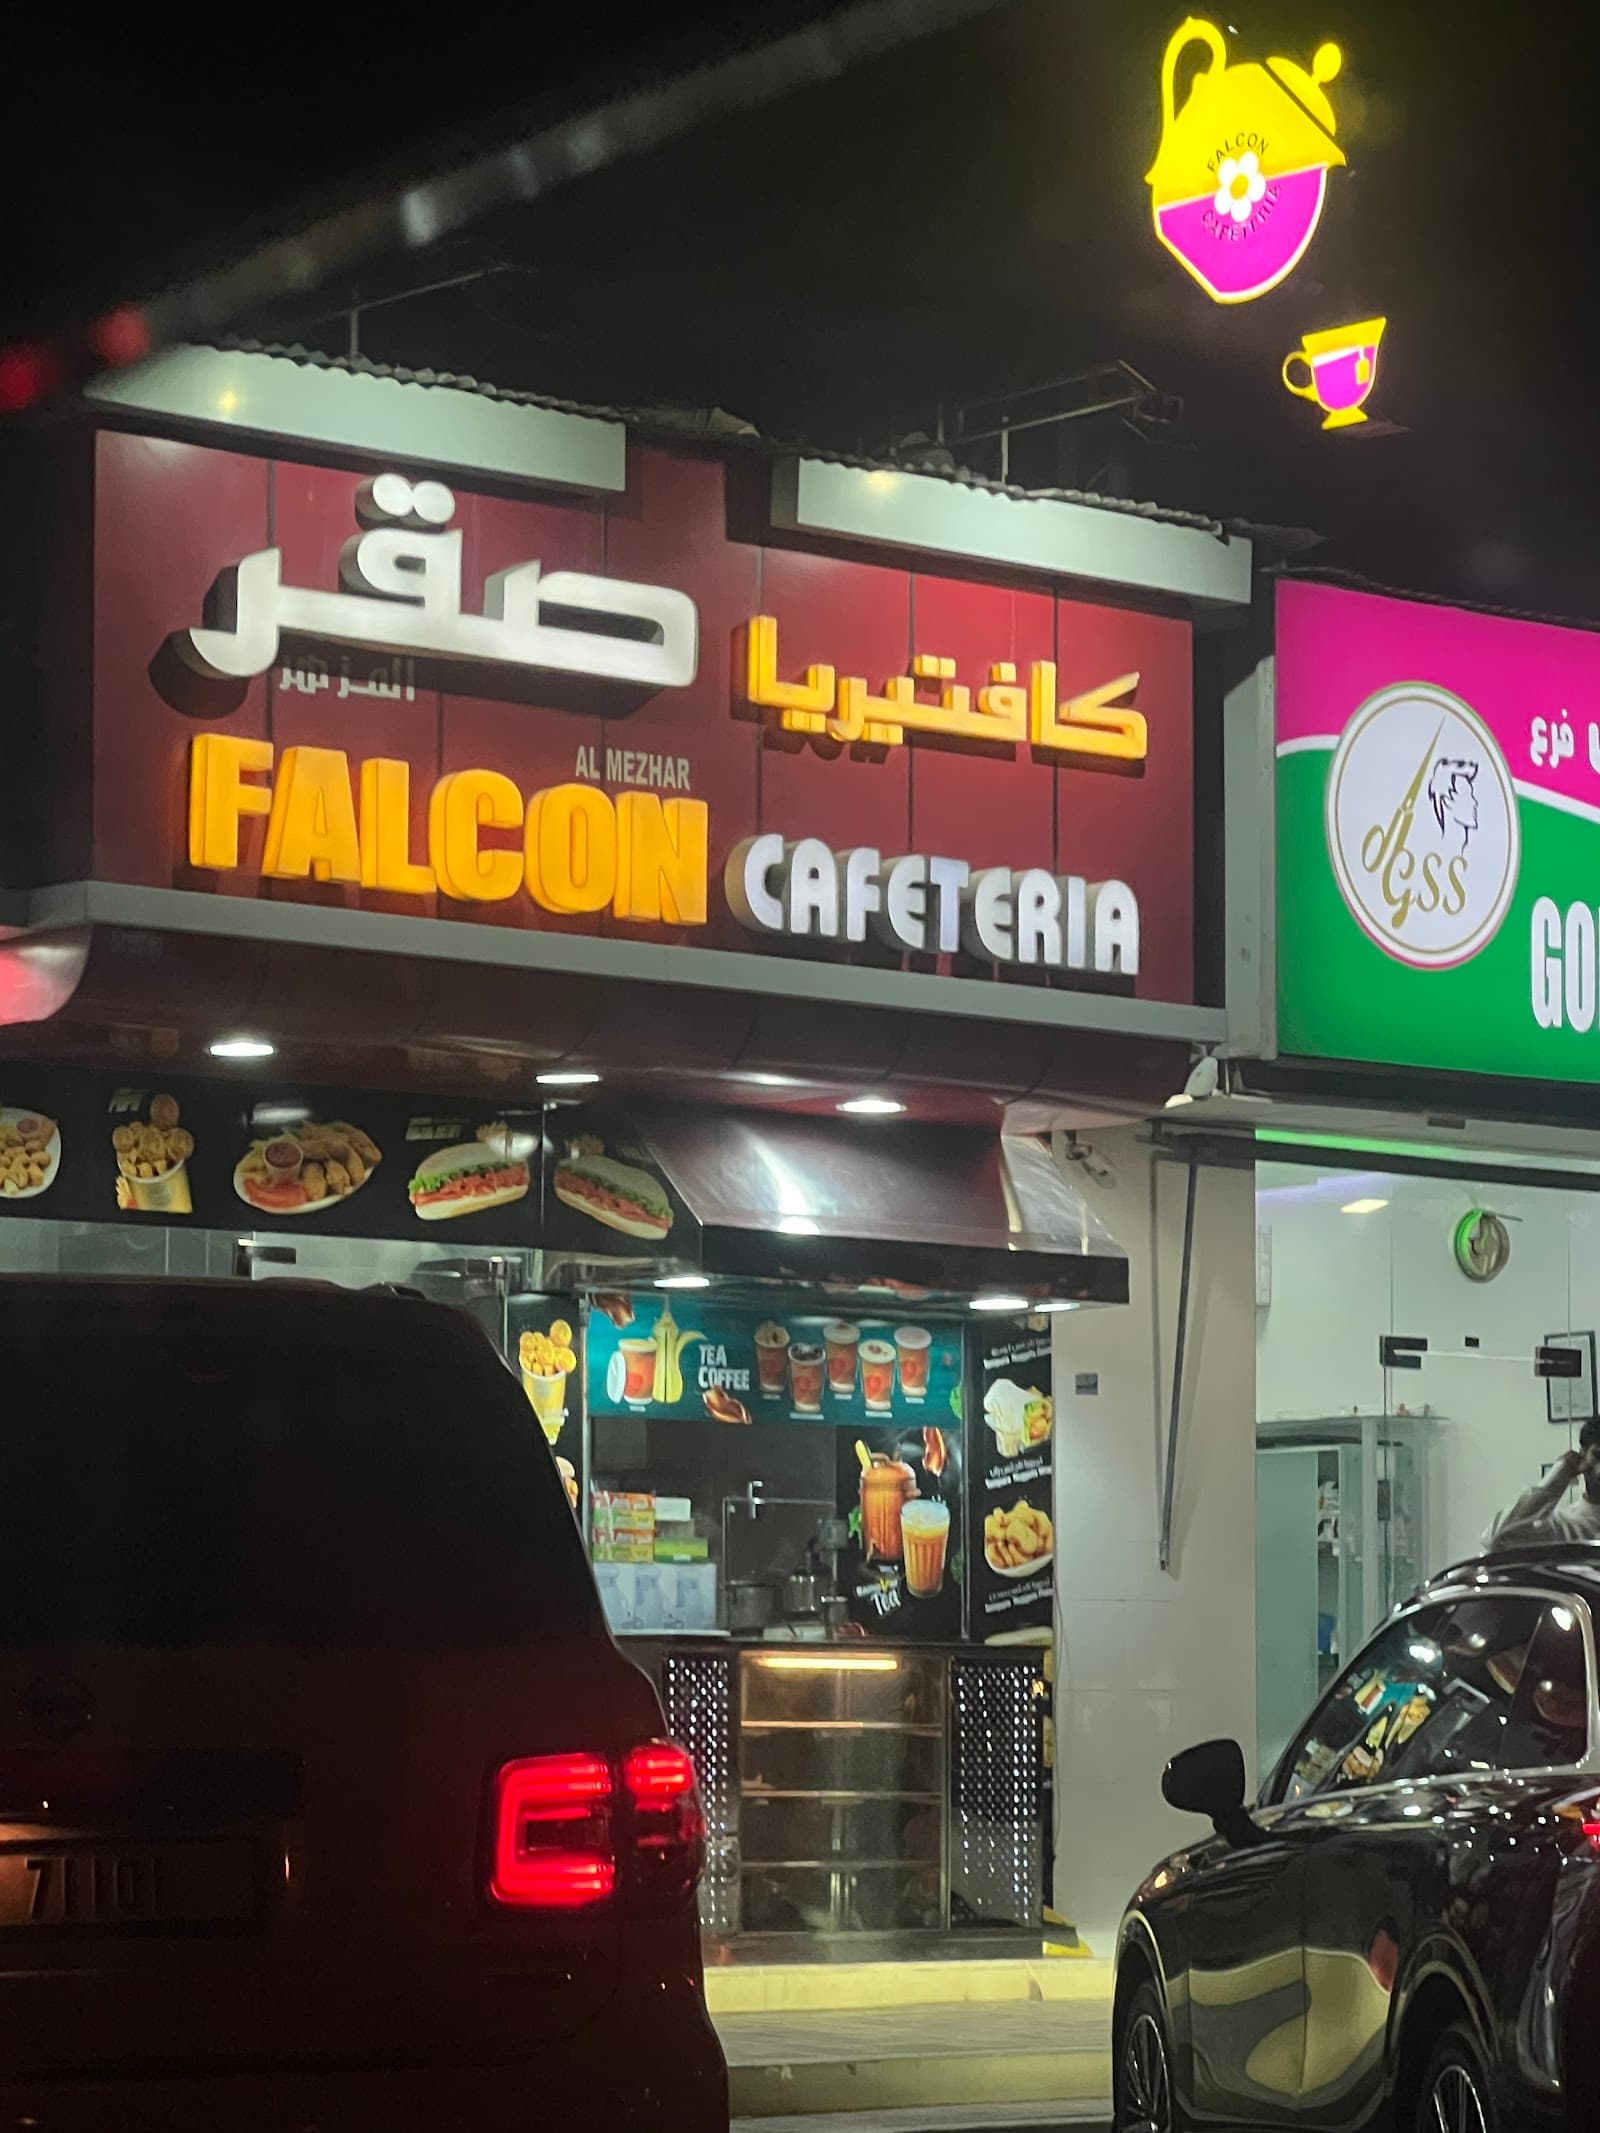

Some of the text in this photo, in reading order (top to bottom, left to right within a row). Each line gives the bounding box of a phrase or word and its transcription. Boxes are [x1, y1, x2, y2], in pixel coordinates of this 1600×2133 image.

[1207, 131, 1270, 173] FALCON
[189, 472, 699, 687] صقر
[746, 614, 1149, 760] كافتيريا
[575, 745, 691, 792] AL MEZHAR
[1529, 707, 1575, 770] فرع
[188, 734, 709, 926] FALCON
[733, 832, 1141, 977] CAFETERIA
[698, 1365, 751, 1391] COFFEE
[699, 1343, 728, 1369] TEA
